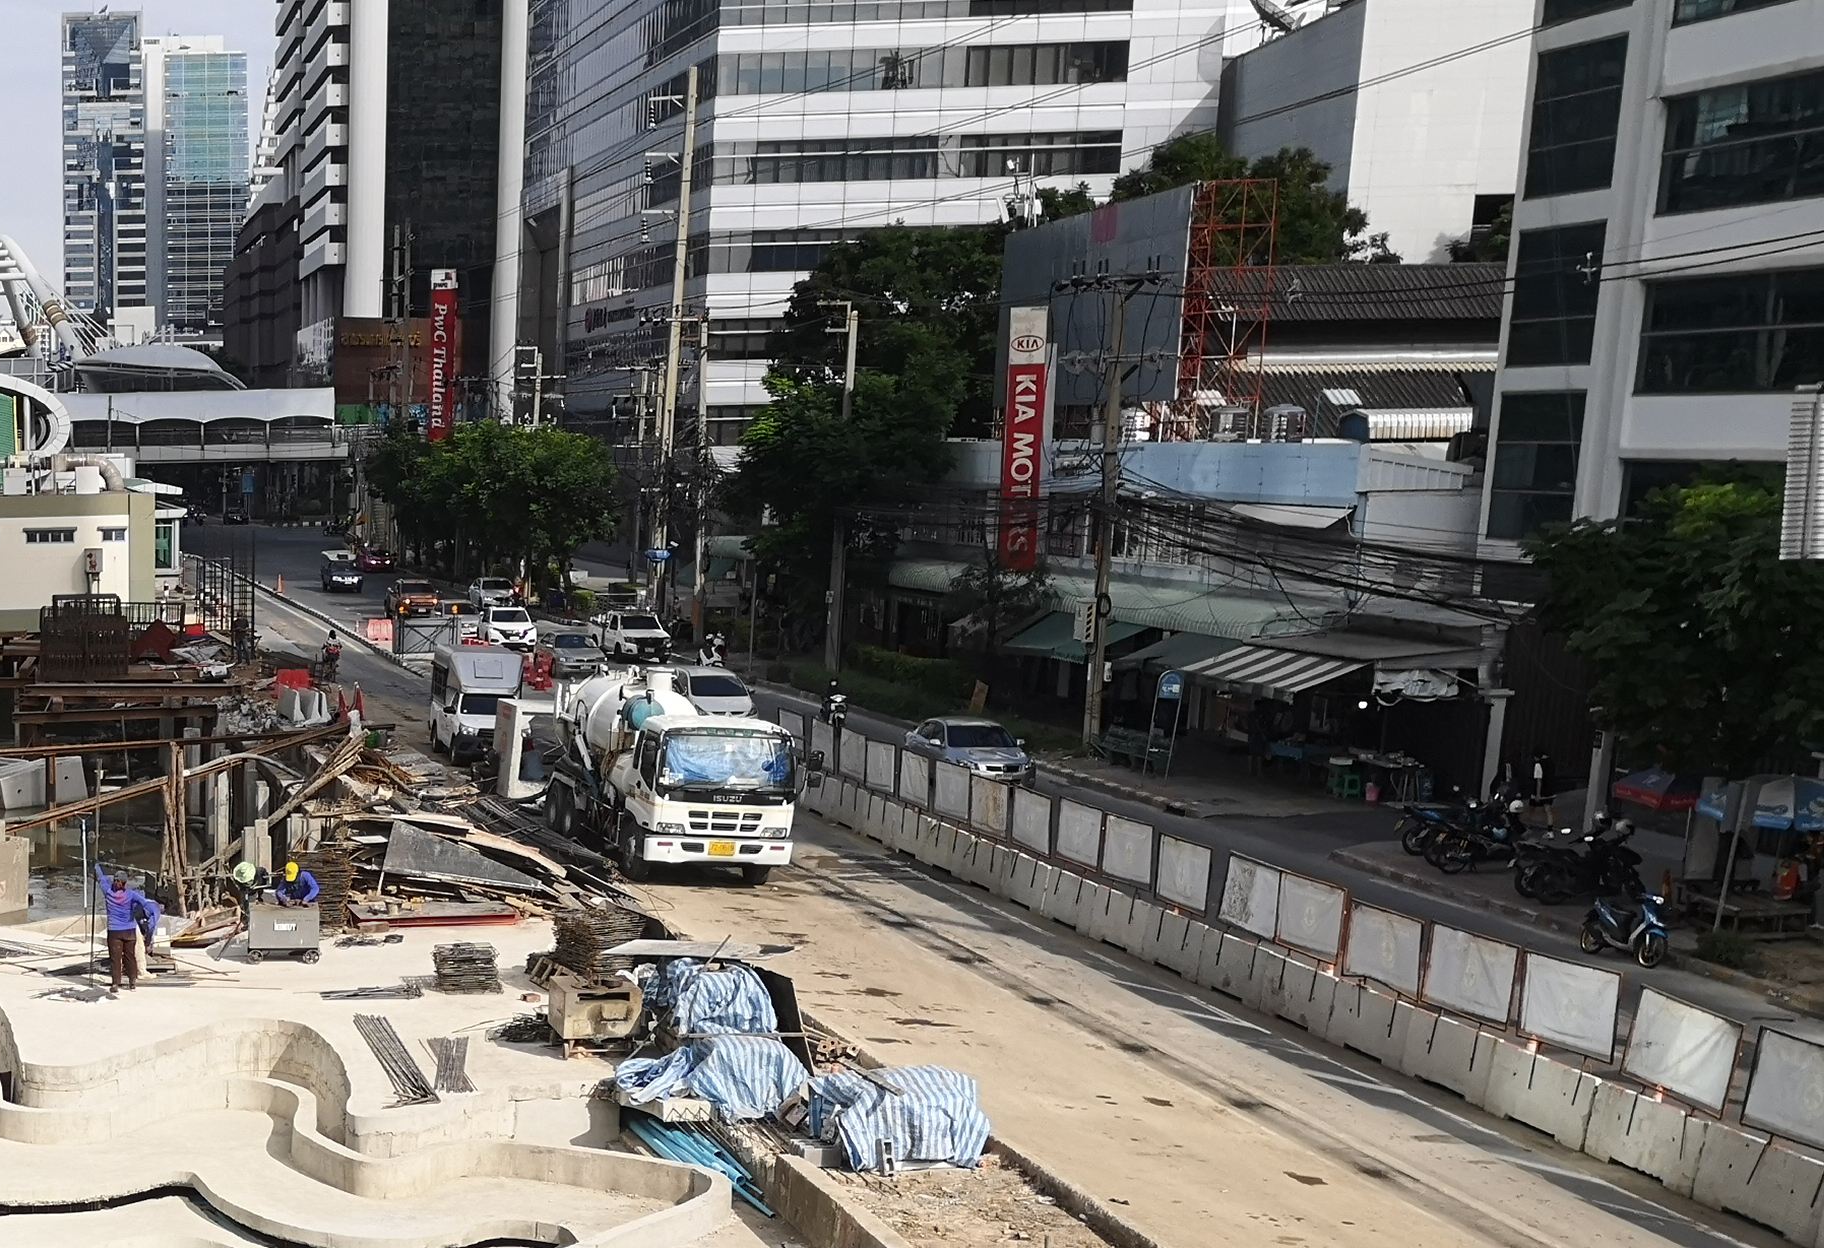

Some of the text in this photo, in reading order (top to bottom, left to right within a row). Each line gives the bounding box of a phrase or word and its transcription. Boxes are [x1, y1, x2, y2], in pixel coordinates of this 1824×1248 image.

[1016, 338, 1040, 349] KIA
[431, 302, 448, 429] PwC Thailand
[1014, 374, 1037, 424] KIA
[712, 795, 743, 803] ISUZU
